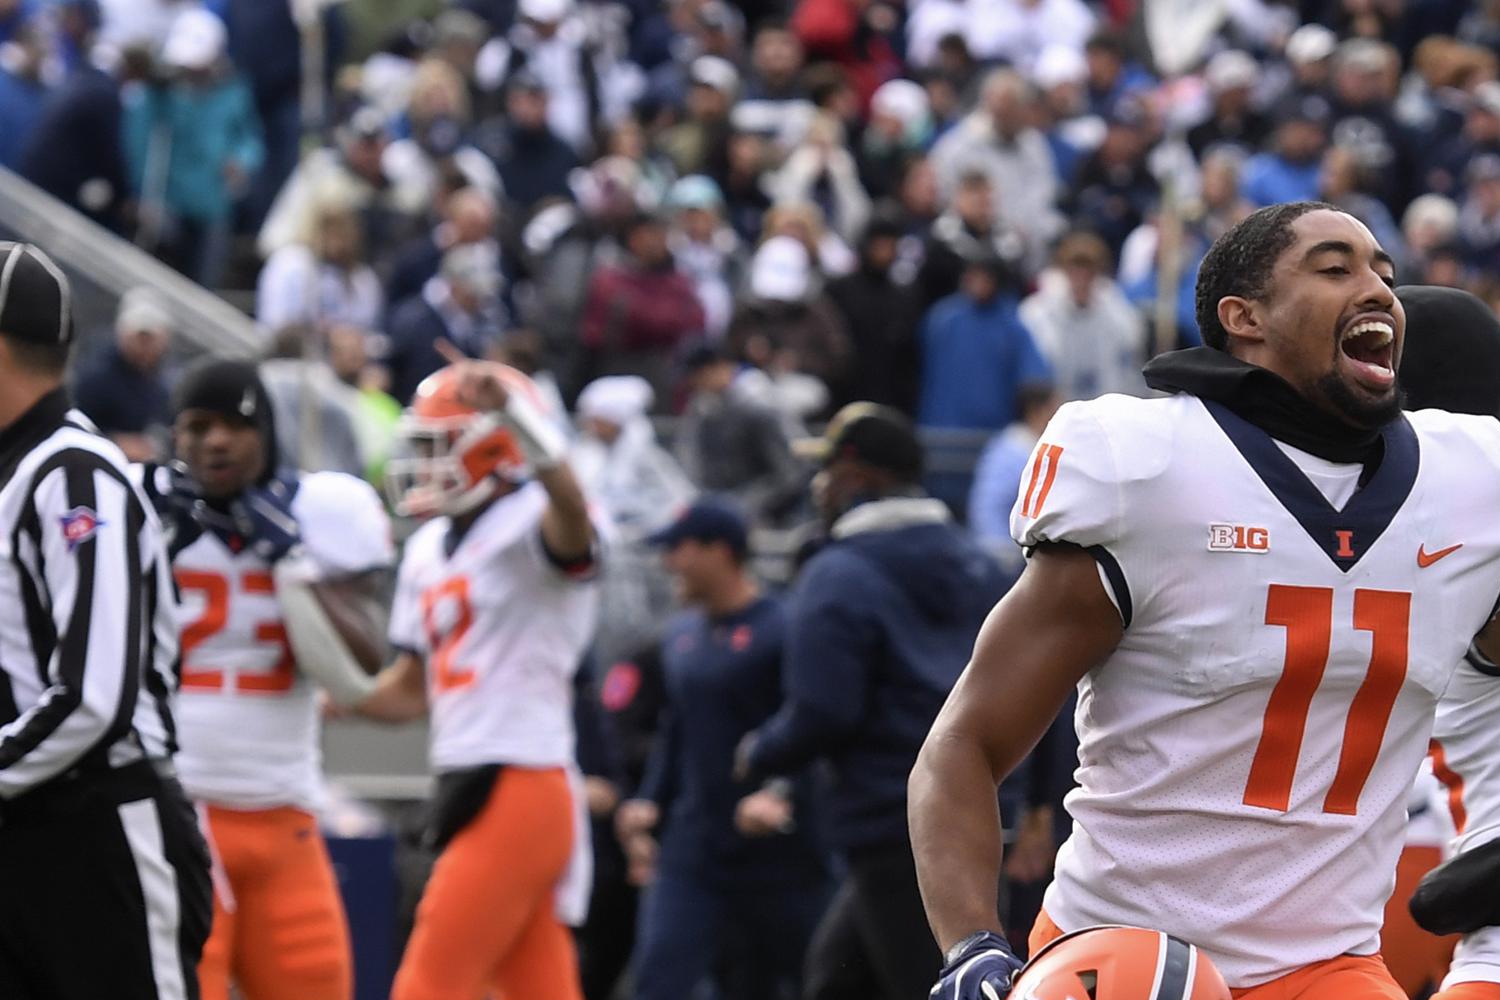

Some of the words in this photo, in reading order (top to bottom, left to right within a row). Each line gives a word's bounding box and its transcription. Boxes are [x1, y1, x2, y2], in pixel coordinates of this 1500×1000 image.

[1020, 443, 1064, 519] 11
[1335, 530, 1355, 557] I
[173, 569, 298, 692] 23
[1243, 584, 1412, 816] 11
